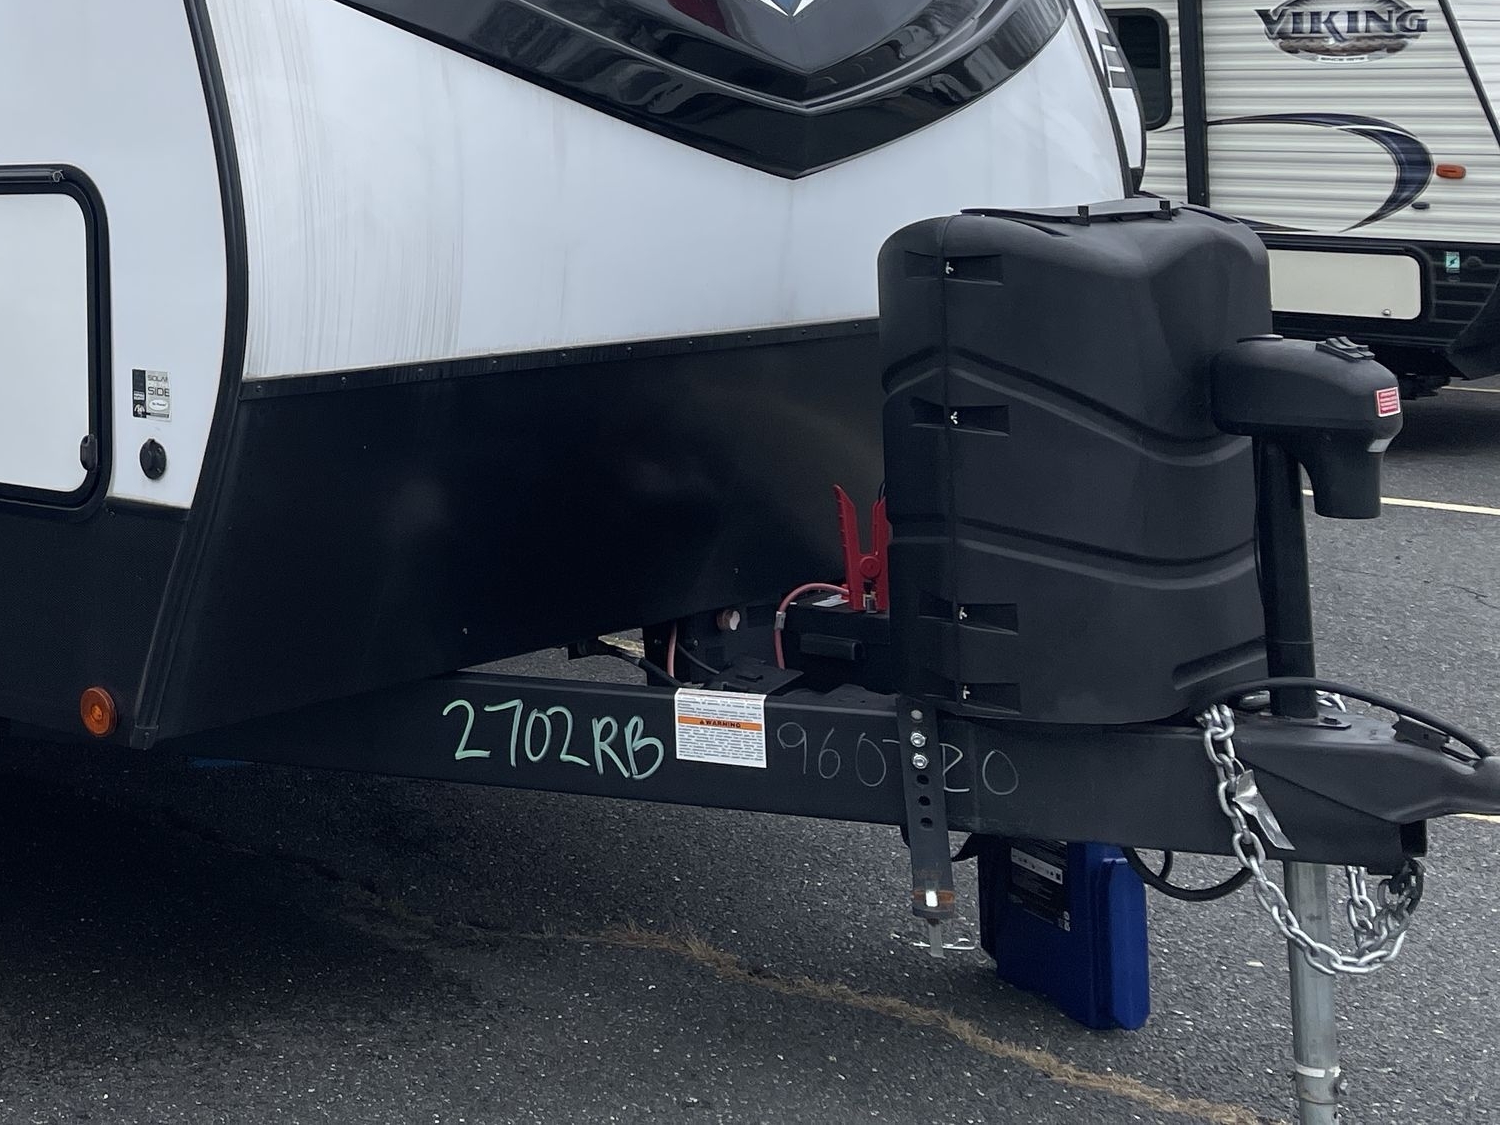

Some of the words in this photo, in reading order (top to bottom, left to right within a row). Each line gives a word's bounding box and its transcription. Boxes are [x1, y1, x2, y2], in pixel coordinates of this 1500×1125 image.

[1255, 9, 1428, 42] VIKING
[147, 386, 170, 397] SIDE
[706, 719, 741, 728] WARNING
[443, 699, 664, 780] 2702RB
